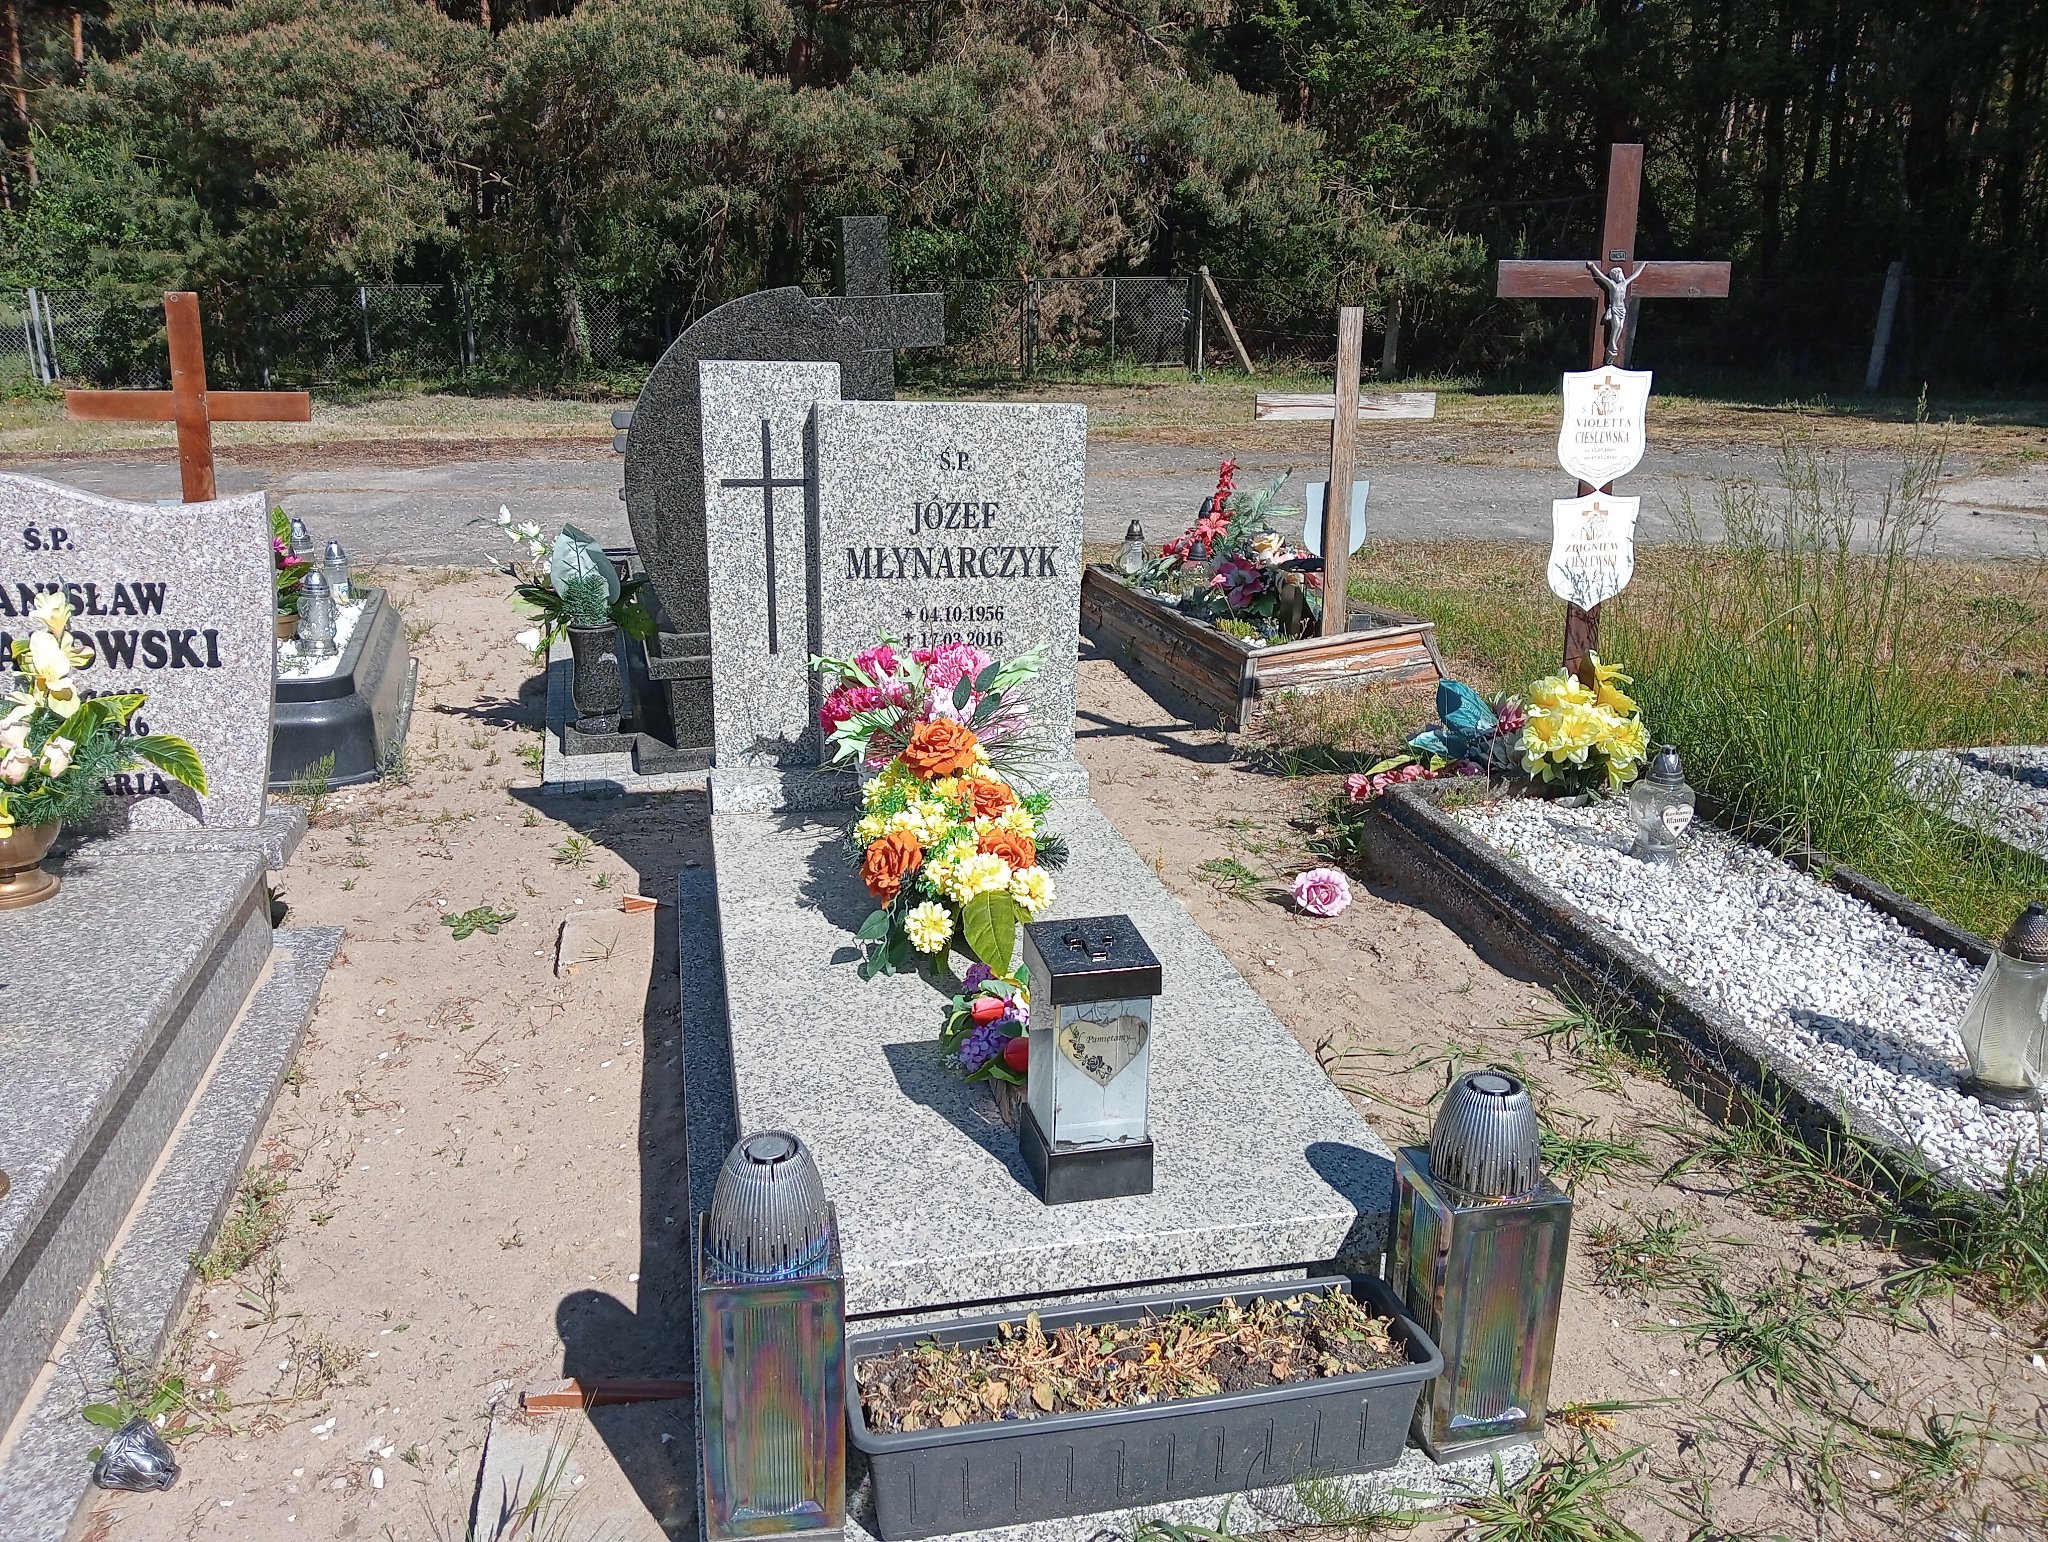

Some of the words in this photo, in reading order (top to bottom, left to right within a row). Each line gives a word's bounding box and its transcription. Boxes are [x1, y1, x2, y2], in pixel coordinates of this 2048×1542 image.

[1576, 418, 1631, 428] VIOLETTA
[1574, 428, 1630, 444] CIEŚLEWSKA
[909, 494, 1000, 535] JÓZEF
[23, 521, 74, 551] Ś.P.
[1564, 542, 1619, 553] ZBIGNIEW
[845, 545, 1060, 580] MŁYNARCZYK
[920, 605, 1005, 623] 04.10.1956
[0, 629, 222, 671] AOWSKI
[1086, 1034, 1131, 1044] Pamiętamy
